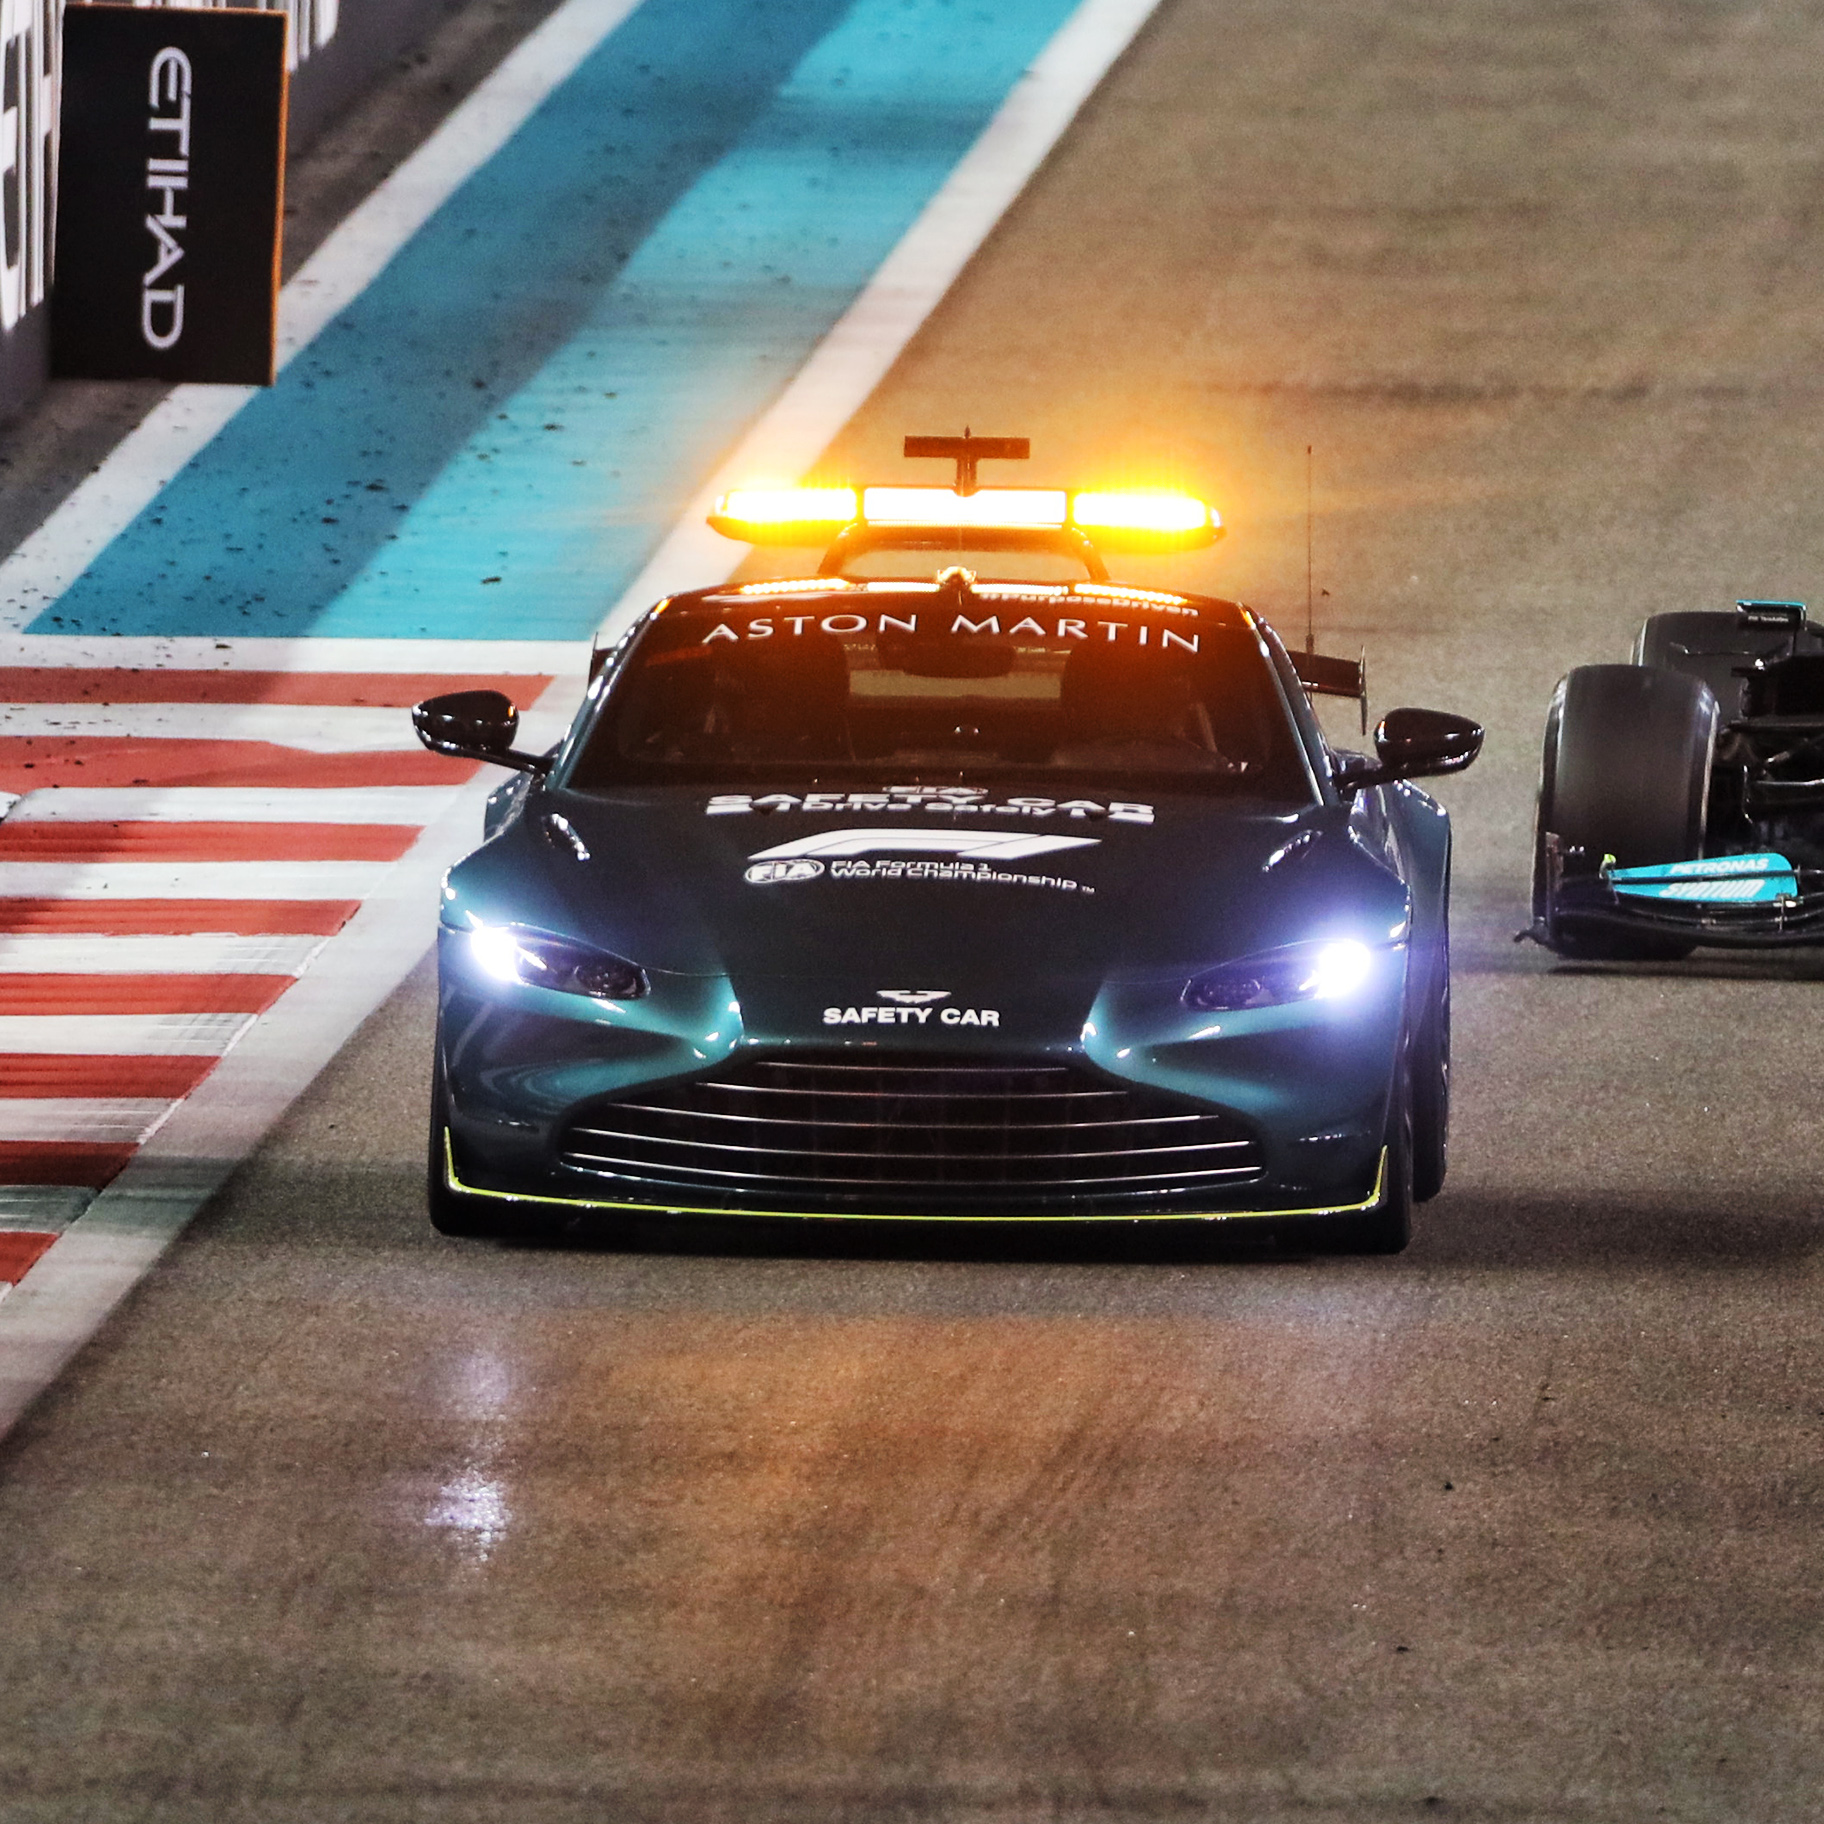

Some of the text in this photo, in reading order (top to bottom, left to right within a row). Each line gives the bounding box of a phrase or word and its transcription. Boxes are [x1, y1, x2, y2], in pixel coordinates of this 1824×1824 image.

[140, 46, 193, 351] ETIHAD
[701, 613, 1200, 654] ASTON MARTIN
[749, 862, 821, 882] FIA
[831, 860, 871, 870] FIA
[875, 861, 975, 872] Formula
[1670, 858, 1769, 875] PETRONAS
[831, 868, 901, 879] World
[906, 869, 1078, 891] Championship
[822, 1007, 1001, 1027] SAFETY CAR
